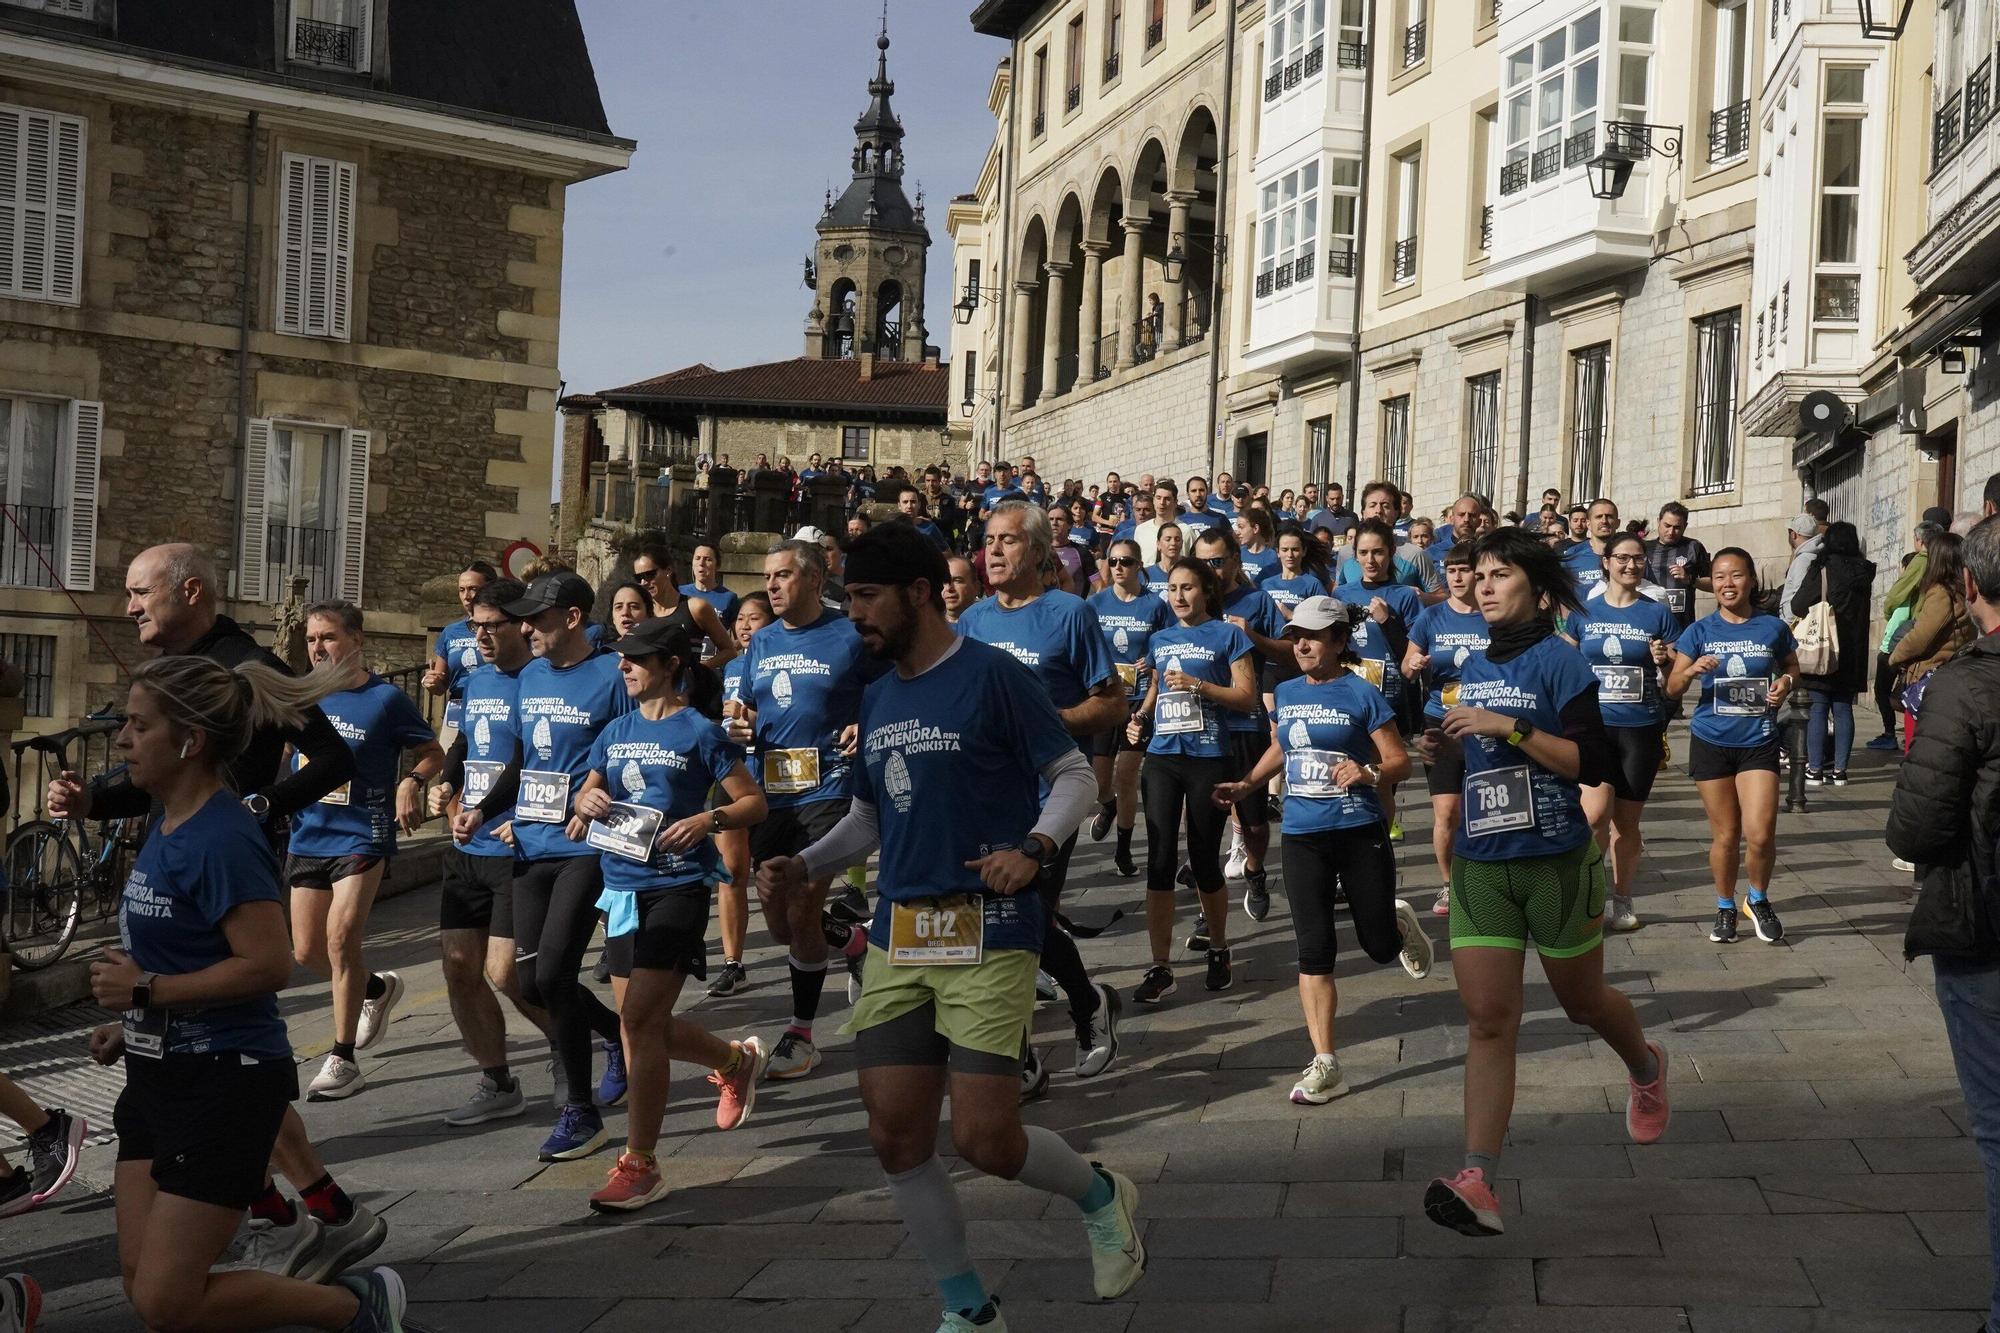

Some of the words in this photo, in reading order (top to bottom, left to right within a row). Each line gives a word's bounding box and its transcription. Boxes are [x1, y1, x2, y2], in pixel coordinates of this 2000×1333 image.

[1593, 627, 1645, 636] ALMENDRA
[1713, 639, 1754, 648] CONQUISTA
[1715, 644, 1767, 654] ALMENDRA
[764, 653, 804, 663] CONQUISTA
[1180, 653, 1215, 661] KONKISTA
[763, 659, 819, 671] ALMENDRA
[790, 666, 831, 676] KONKISTA
[1465, 679, 1505, 691] CONQUISTA
[1604, 674, 1630, 689] 822
[1459, 686, 1522, 701] ALMENDRA
[1521, 692, 1537, 700] REN
[1729, 687, 1756, 702] 945
[528, 697, 564, 706] CONQUISTA
[1486, 697, 1537, 710] KONKISTA
[469, 705, 511, 715] ALMENDR
[526, 704, 579, 716] ALMENDRA
[1161, 701, 1191, 719] 1006
[1281, 708, 1338, 720] ALMENDRA
[1283, 703, 1322, 713] CONQUISTA
[550, 714, 590, 726] KONKISTA
[1307, 717, 1350, 726] KONKISTA
[872, 718, 921, 739] CONQUISTA
[870, 725, 942, 753] ALMENDRA
[942, 732, 960, 740] REN
[612, 742, 660, 751] CONQUISTA
[905, 740, 961, 756] KONKISTA
[610, 749, 676, 760] ALMENDRA
[640, 757, 687, 771] KONKISTA
[775, 759, 802, 777] 158
[1300, 762, 1329, 780] 972
[1514, 771, 1524, 779] 5K
[468, 772, 490, 791] 898
[524, 782, 556, 803] 1029
[1477, 784, 1510, 811] 738
[154, 896, 173, 906] REN
[915, 910, 957, 938] 612
